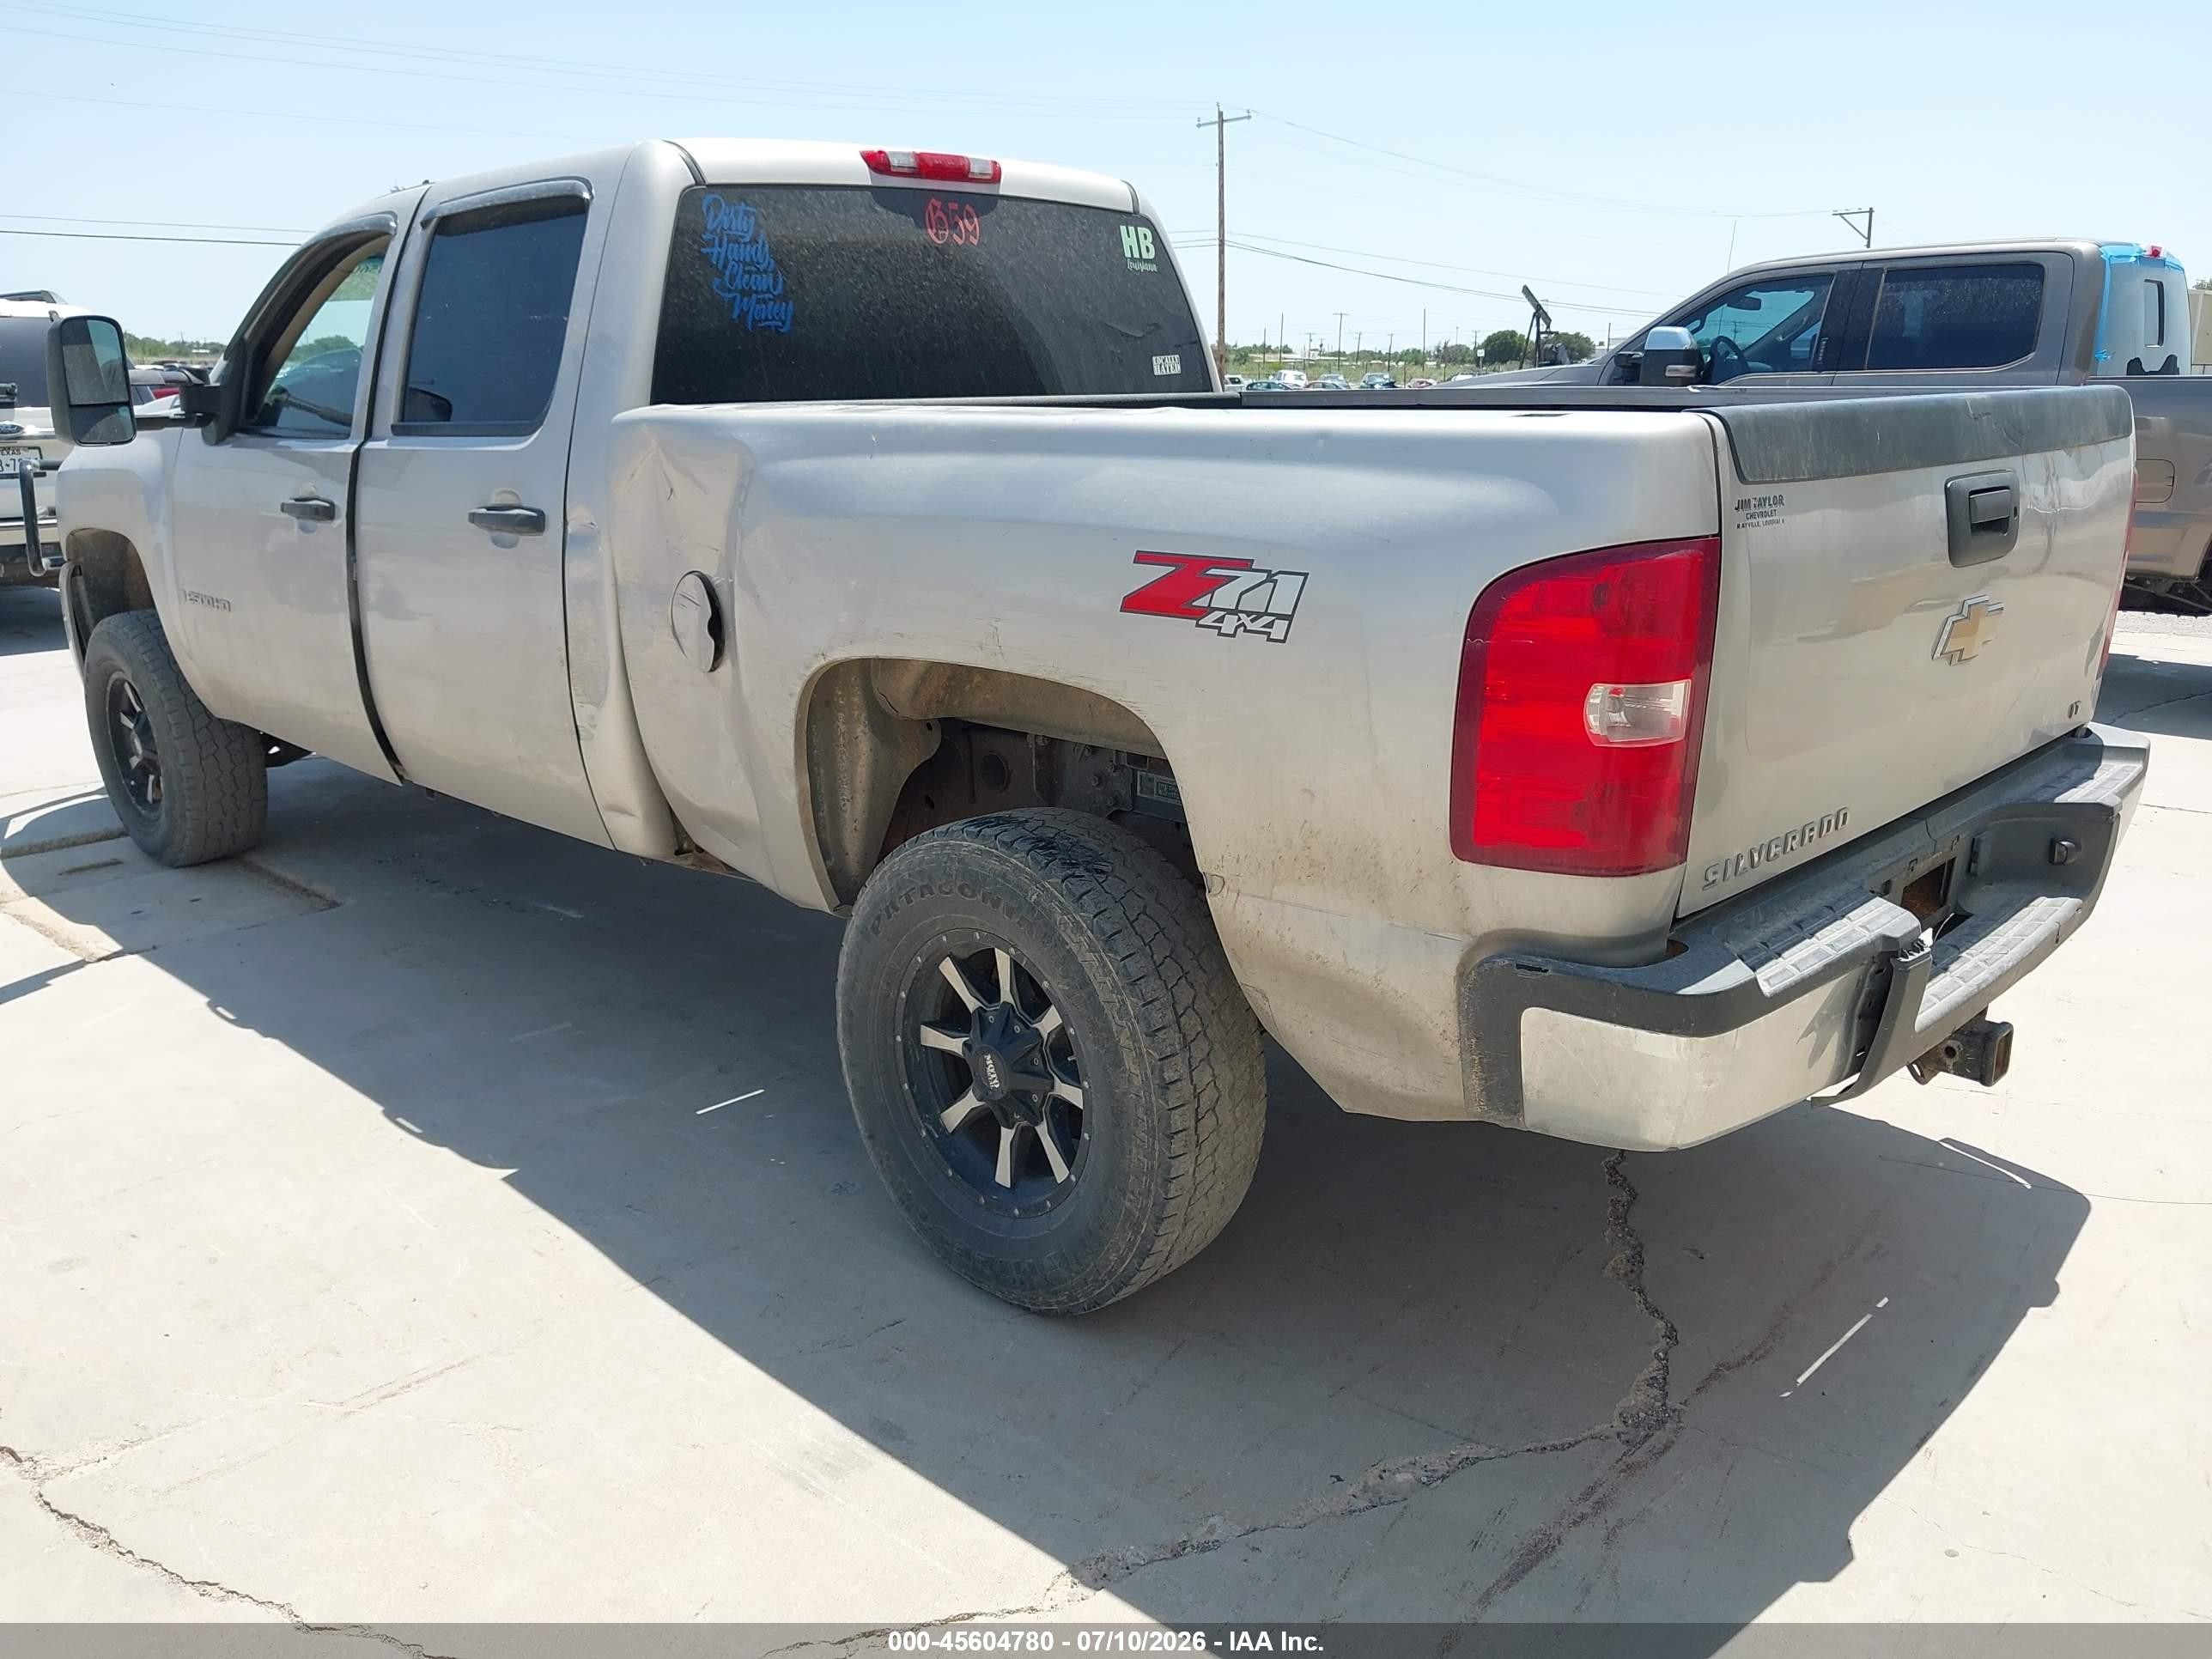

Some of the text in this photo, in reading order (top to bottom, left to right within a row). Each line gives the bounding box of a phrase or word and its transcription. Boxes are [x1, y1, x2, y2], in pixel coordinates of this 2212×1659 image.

[702, 193, 757, 243] Dirty
[926, 198, 979, 246] G59
[1119, 225, 1156, 259] HB
[714, 292, 794, 333] Money
[1735, 494, 1785, 511] JIM TAYLOR
[1745, 509, 1777, 520] CHEVROLET
[1120, 550, 1309, 620] Z71
[1702, 806, 1850, 891] SILVERADO
